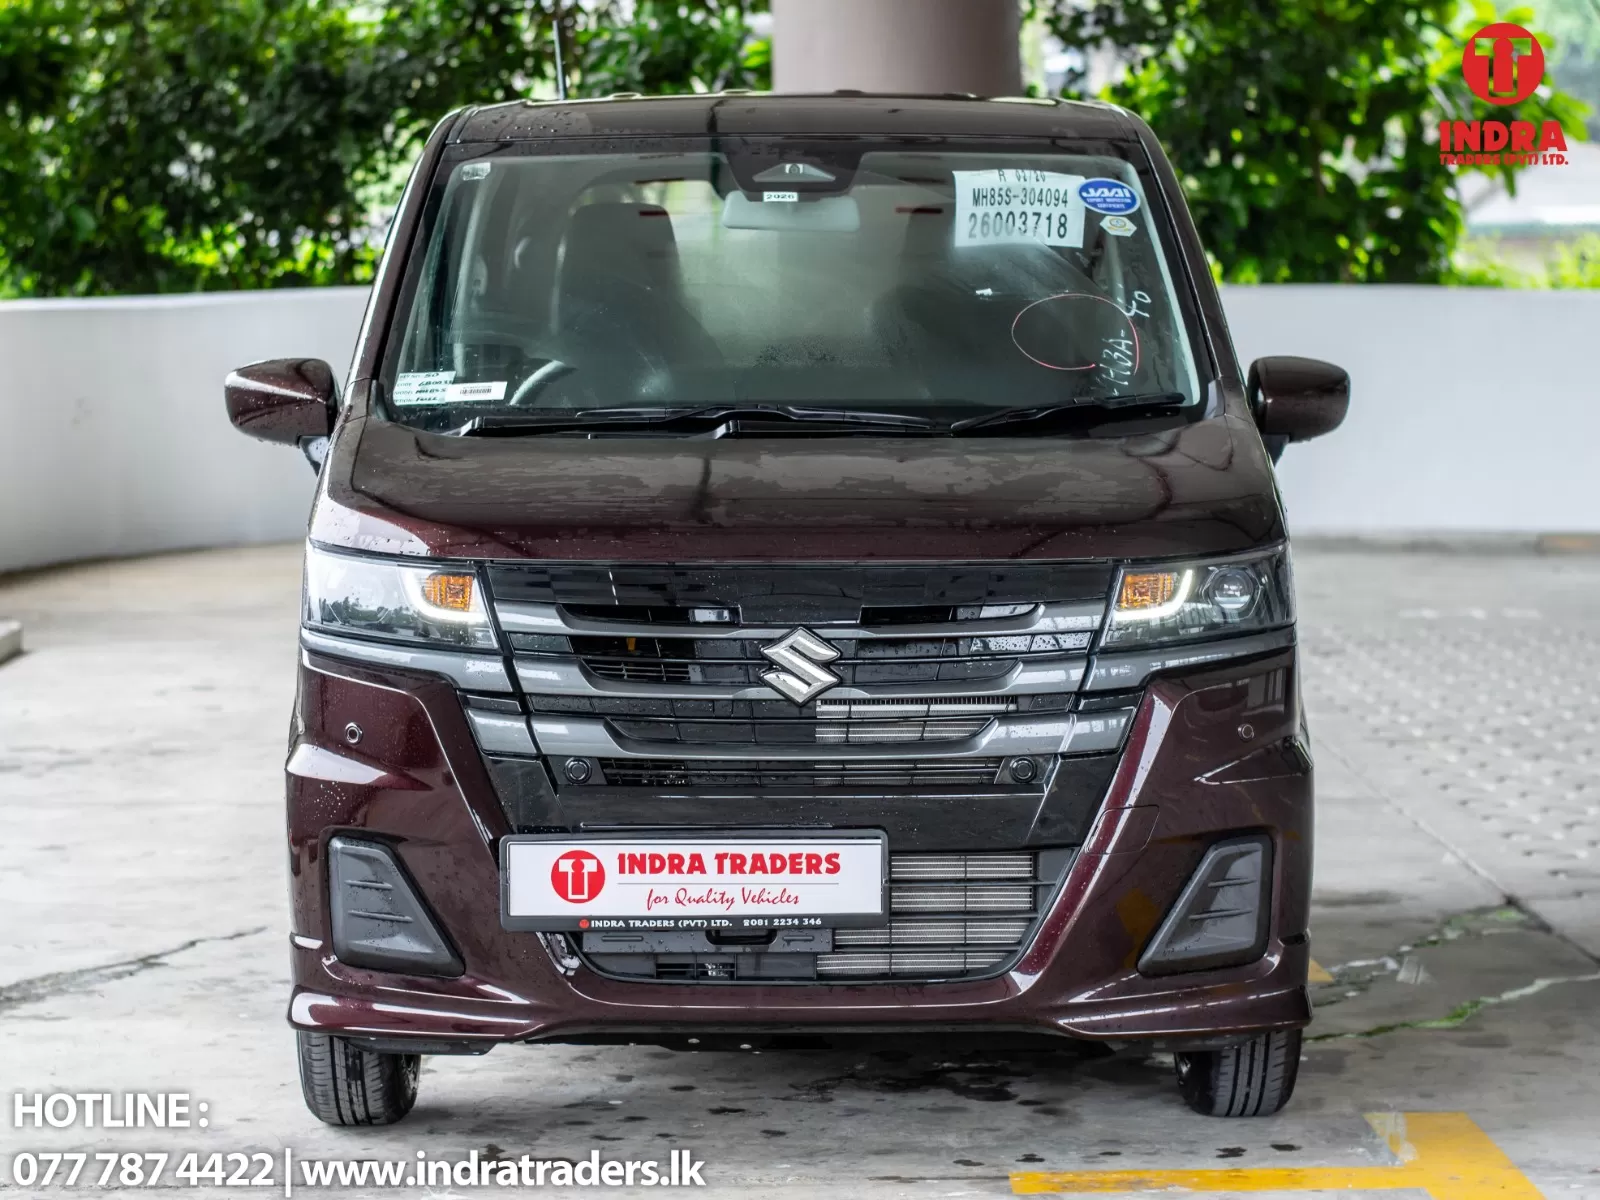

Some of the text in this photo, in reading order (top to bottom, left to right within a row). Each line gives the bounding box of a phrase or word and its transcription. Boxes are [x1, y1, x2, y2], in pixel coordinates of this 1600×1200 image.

[972, 187, 1069, 208] MH85S-304094
[1081, 187, 1132, 198] JAAI
[968, 211, 1068, 239] 26003718
[617, 852, 841, 875] INDRA TRADERS
[647, 887, 799, 911] for Quality Vehicles
[591, 919, 626, 928] INDRA
[628, 919, 675, 928] TRADERS
[678, 919, 708, 928] (PVT)
[710, 919, 733, 927] LTD.
[773, 918, 799, 926] 2234
[802, 917, 822, 925] 346
